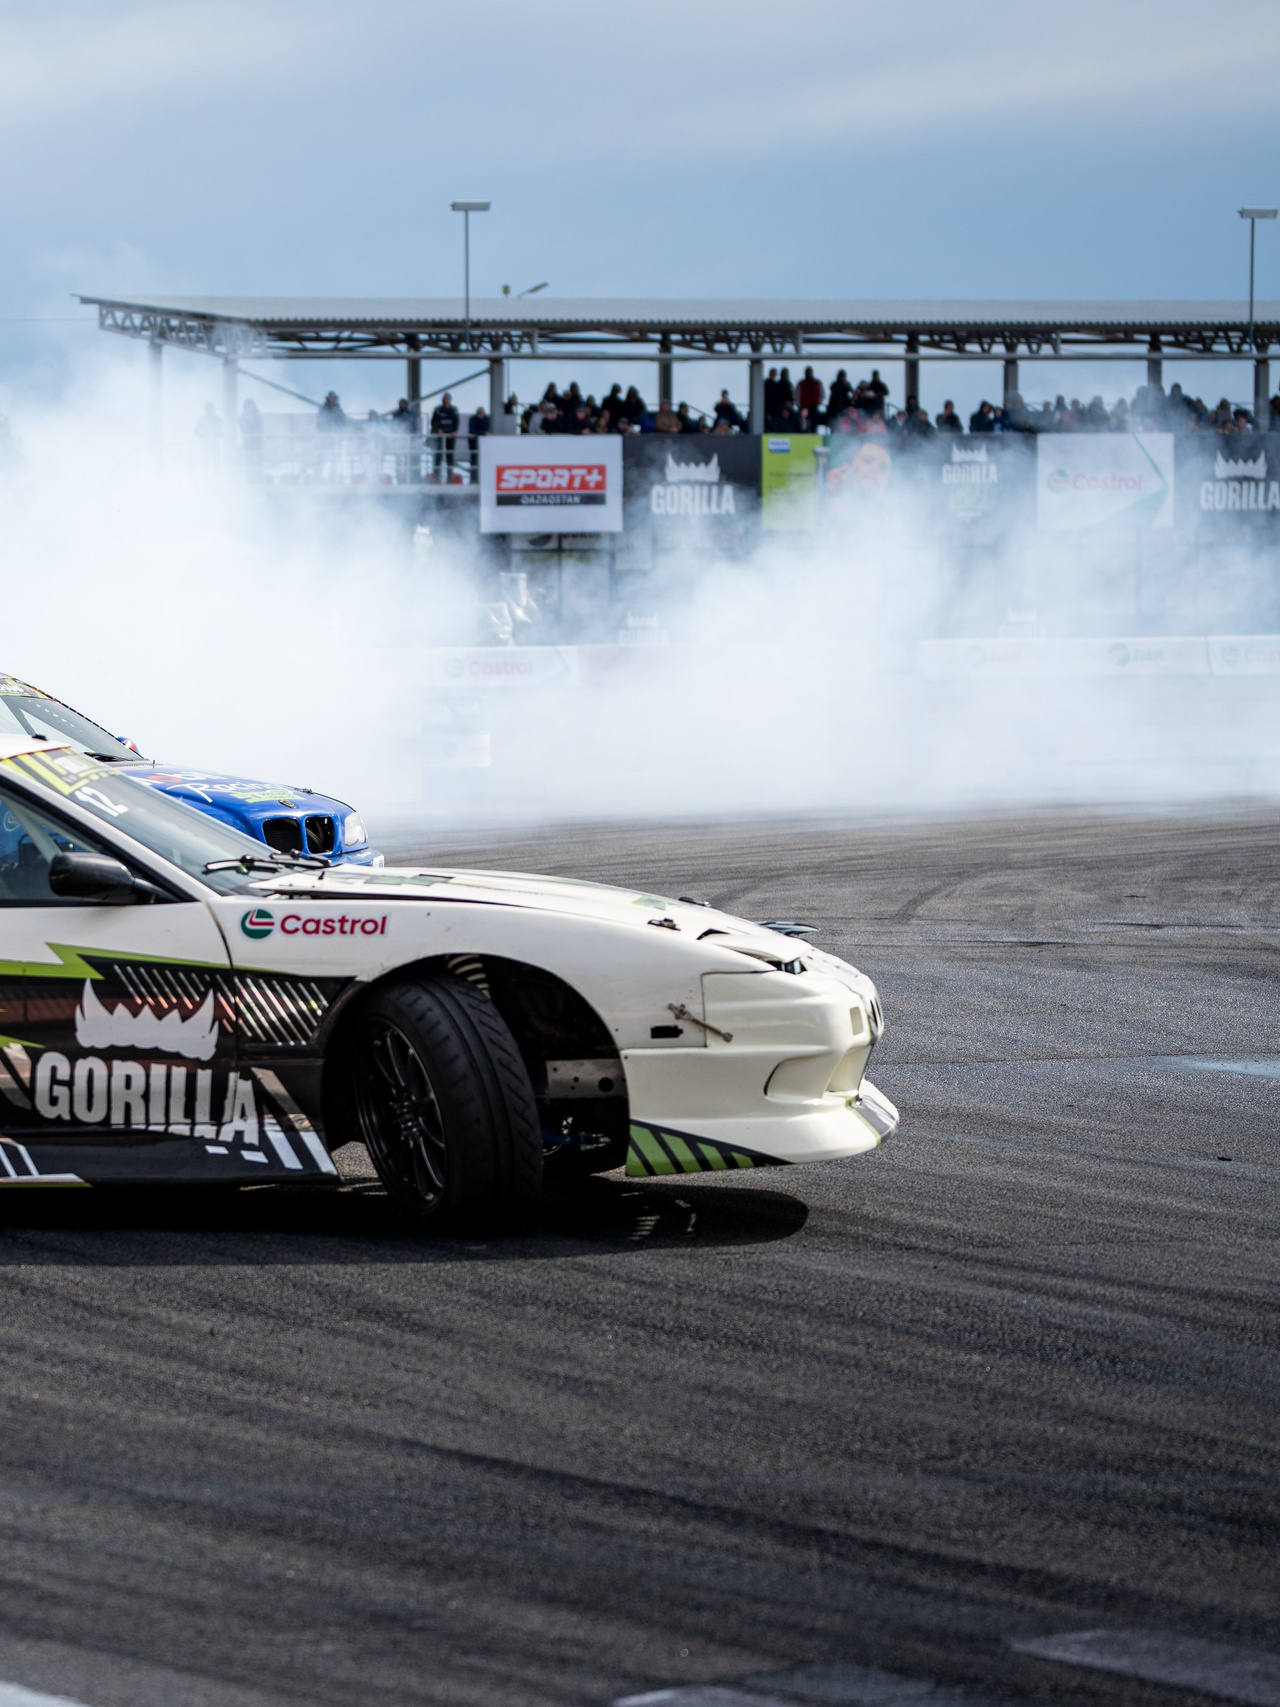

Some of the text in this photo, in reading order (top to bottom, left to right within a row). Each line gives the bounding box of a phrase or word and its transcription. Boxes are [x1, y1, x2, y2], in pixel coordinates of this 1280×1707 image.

[500, 469, 602, 488] SPORT+
[942, 463, 998, 484] GORILLA
[1073, 473, 1142, 492] Castrol
[651, 484, 735, 514] GORILLA
[1200, 480, 1280, 511] GORILLA
[469, 658, 534, 676] Castrol
[74, 786, 129, 817] 12
[280, 914, 388, 935] Castrol
[34, 1051, 260, 1146] GORILLA
